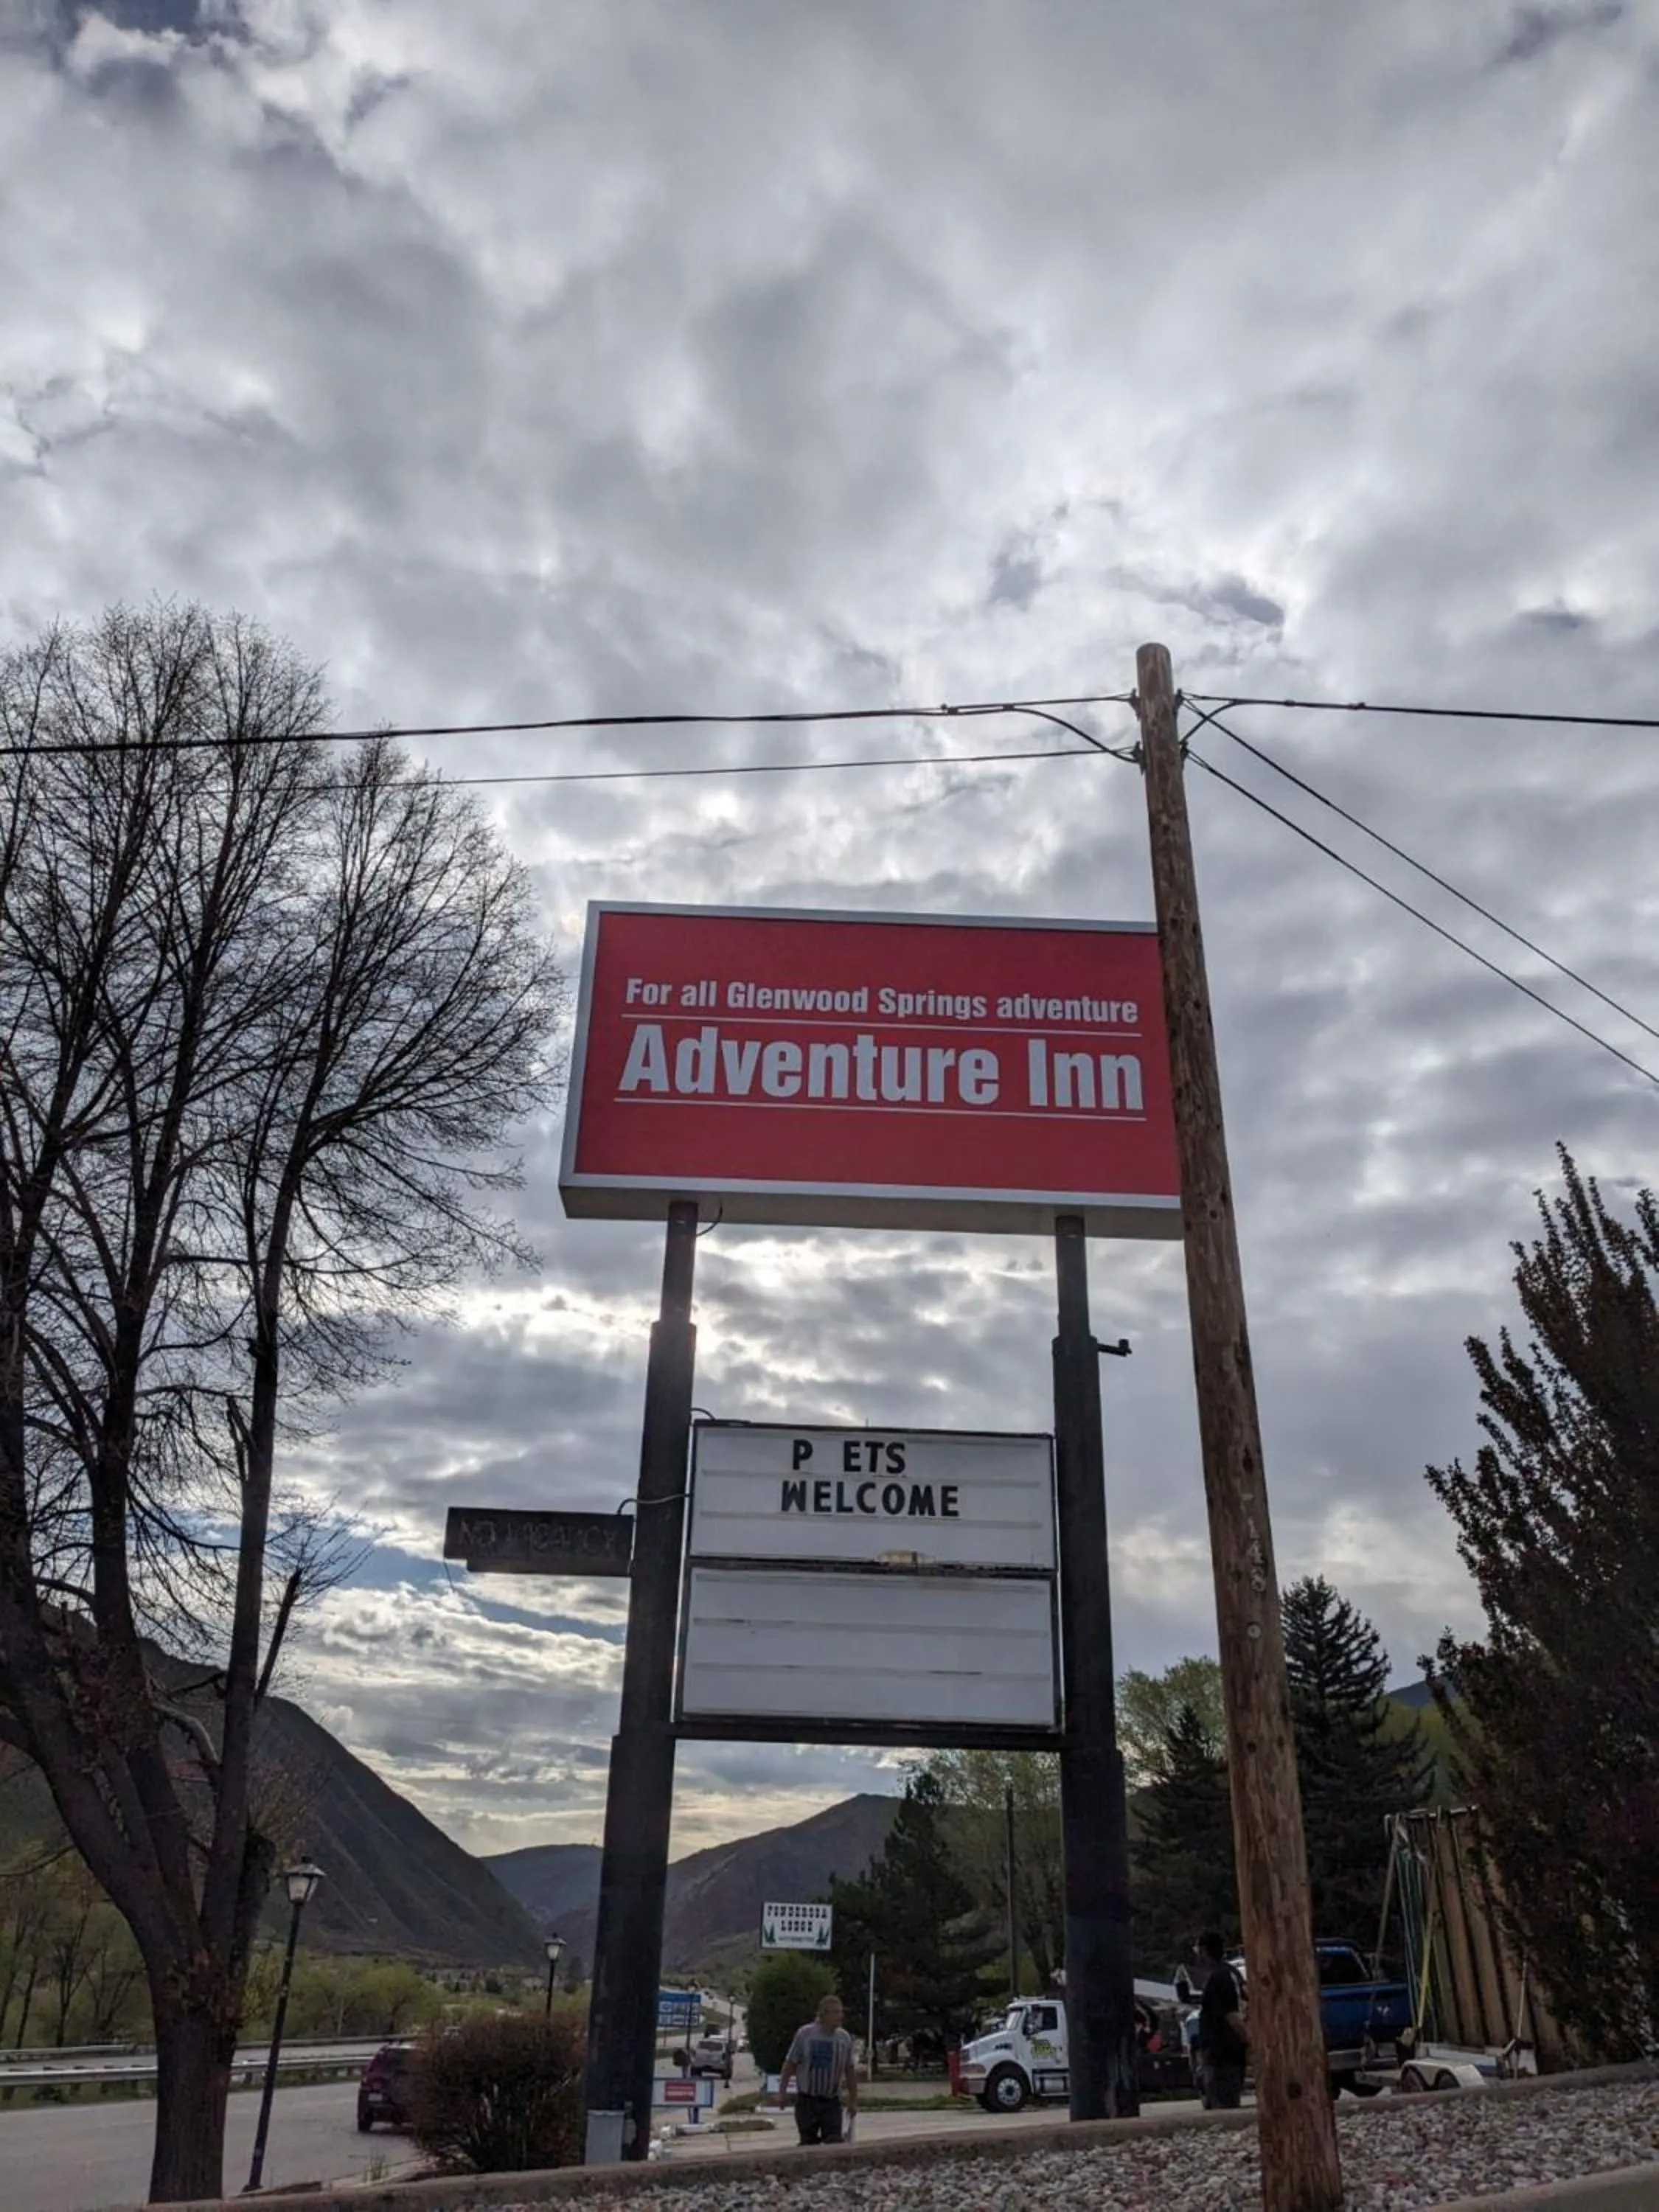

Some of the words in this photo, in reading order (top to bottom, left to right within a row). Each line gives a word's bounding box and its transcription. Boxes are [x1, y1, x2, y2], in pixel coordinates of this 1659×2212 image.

[626, 978, 671, 1005] For
[681, 981, 717, 1008] all
[726, 981, 869, 1013] Glenwood
[877, 988, 987, 1020] Springs
[996, 995, 1139, 1023] adventure
[619, 1023, 1000, 1105] Adventure
[1028, 1038, 1144, 1110] Inn
[781, 1480, 959, 1517] WELCOME
